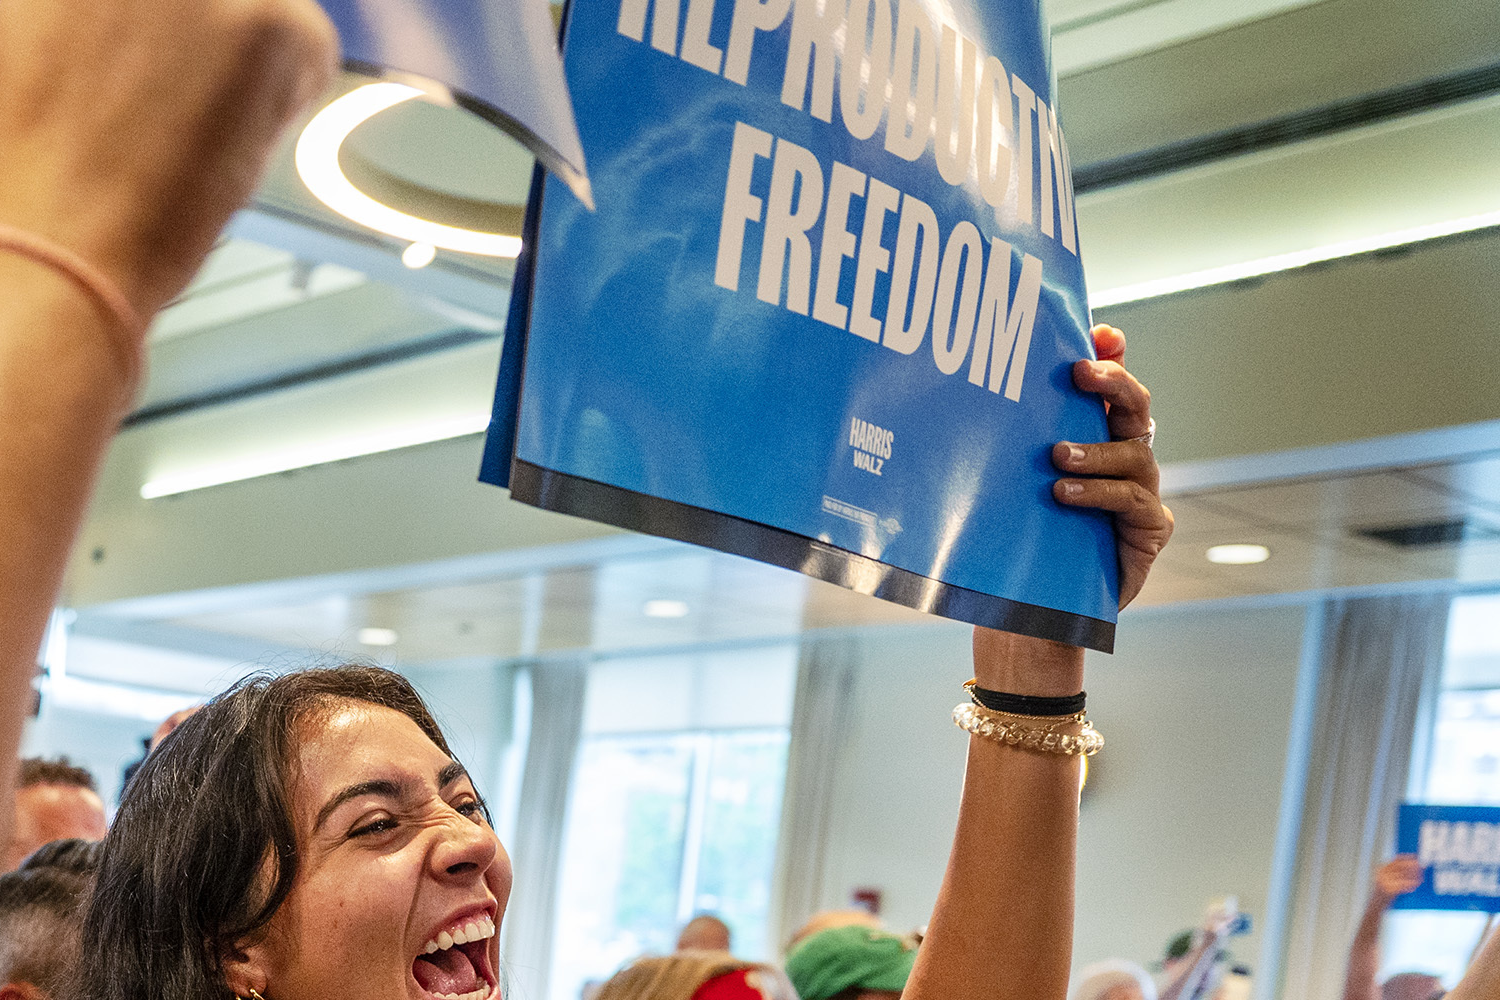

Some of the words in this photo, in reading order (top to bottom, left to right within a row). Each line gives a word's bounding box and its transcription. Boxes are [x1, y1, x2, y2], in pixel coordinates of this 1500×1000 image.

[617, 0, 1077, 257] PRODUCTIV
[714, 121, 1043, 403] FREEDOM
[849, 416, 894, 460] HARRIS
[853, 449, 885, 476] WALZ
